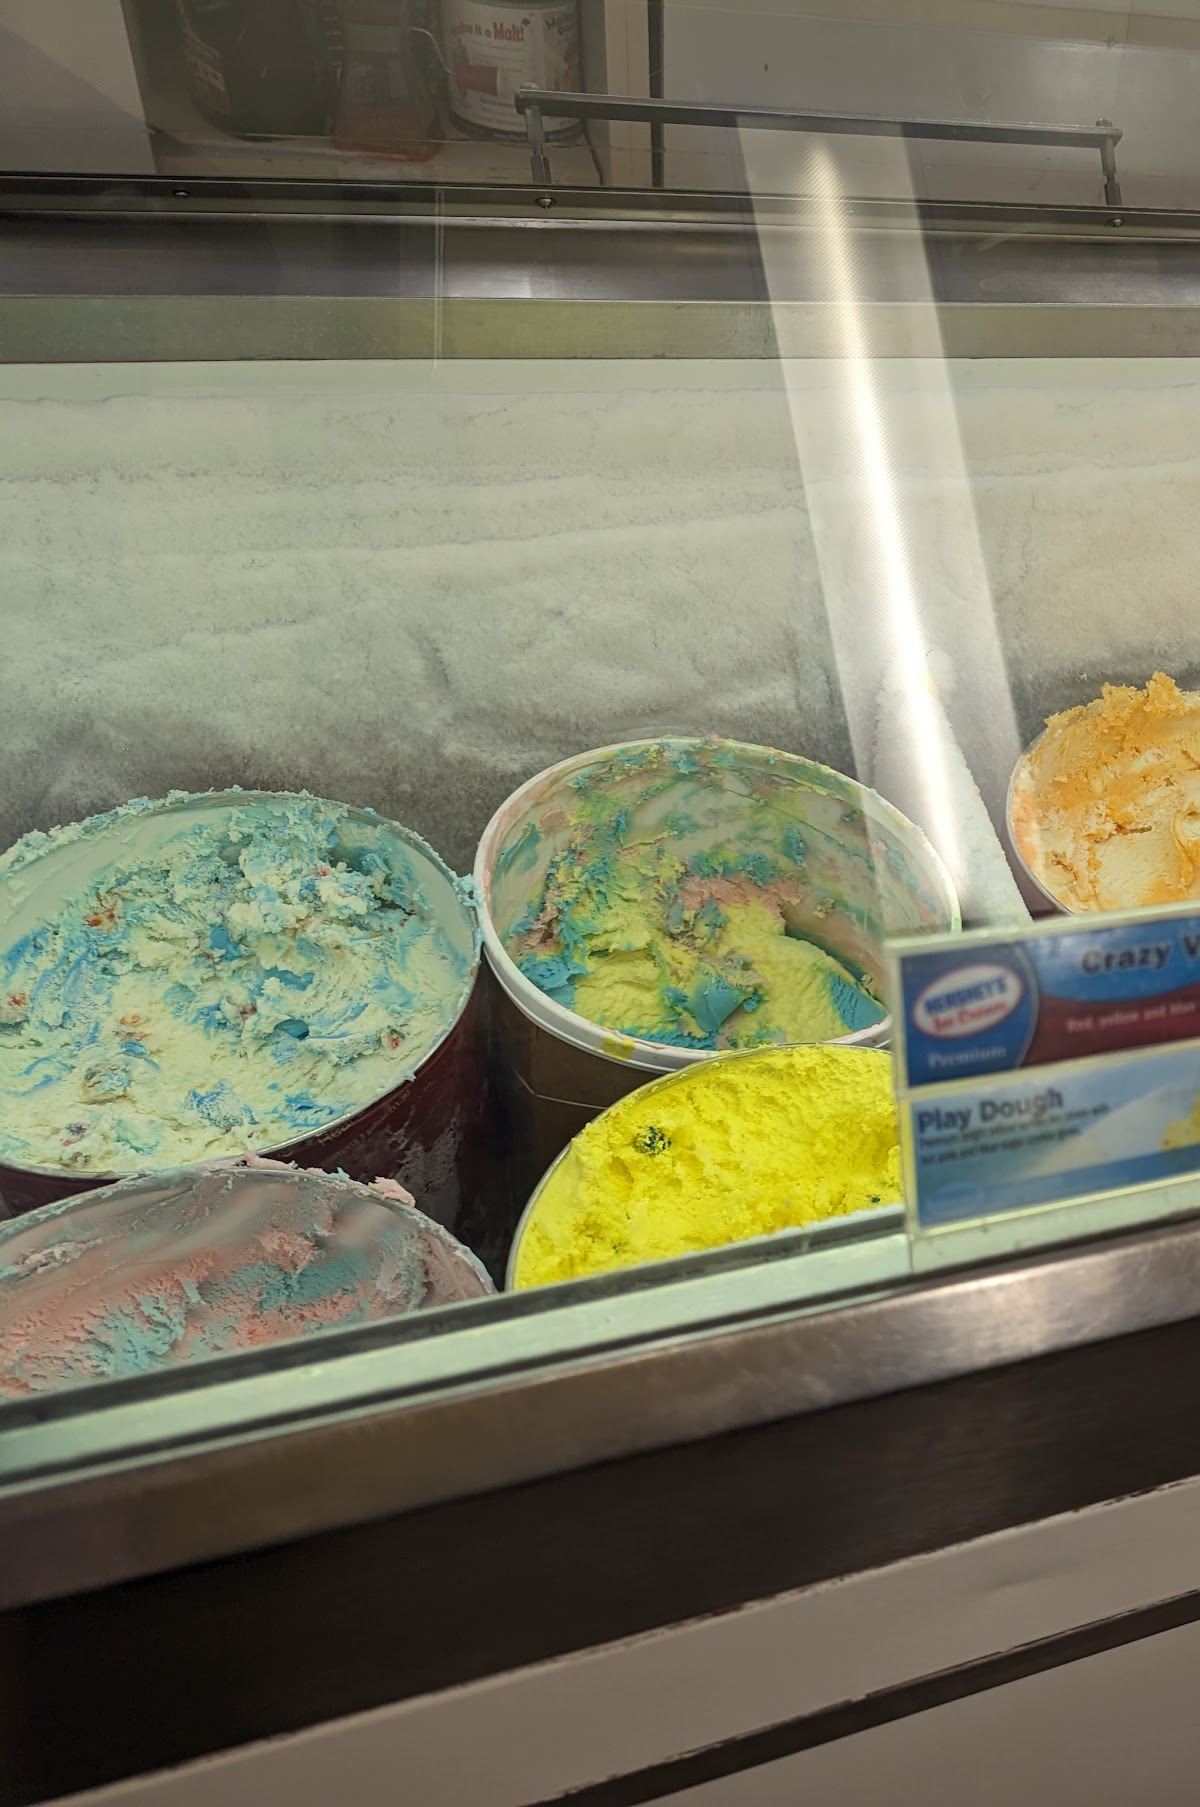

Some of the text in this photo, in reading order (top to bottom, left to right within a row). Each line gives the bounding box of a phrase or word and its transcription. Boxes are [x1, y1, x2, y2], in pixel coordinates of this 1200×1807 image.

[493, 21, 524, 42] Malt!
[1081, 944, 1171, 975] Crazy
[918, 1106, 972, 1134] Play
[979, 1086, 1064, 1122] Dough
